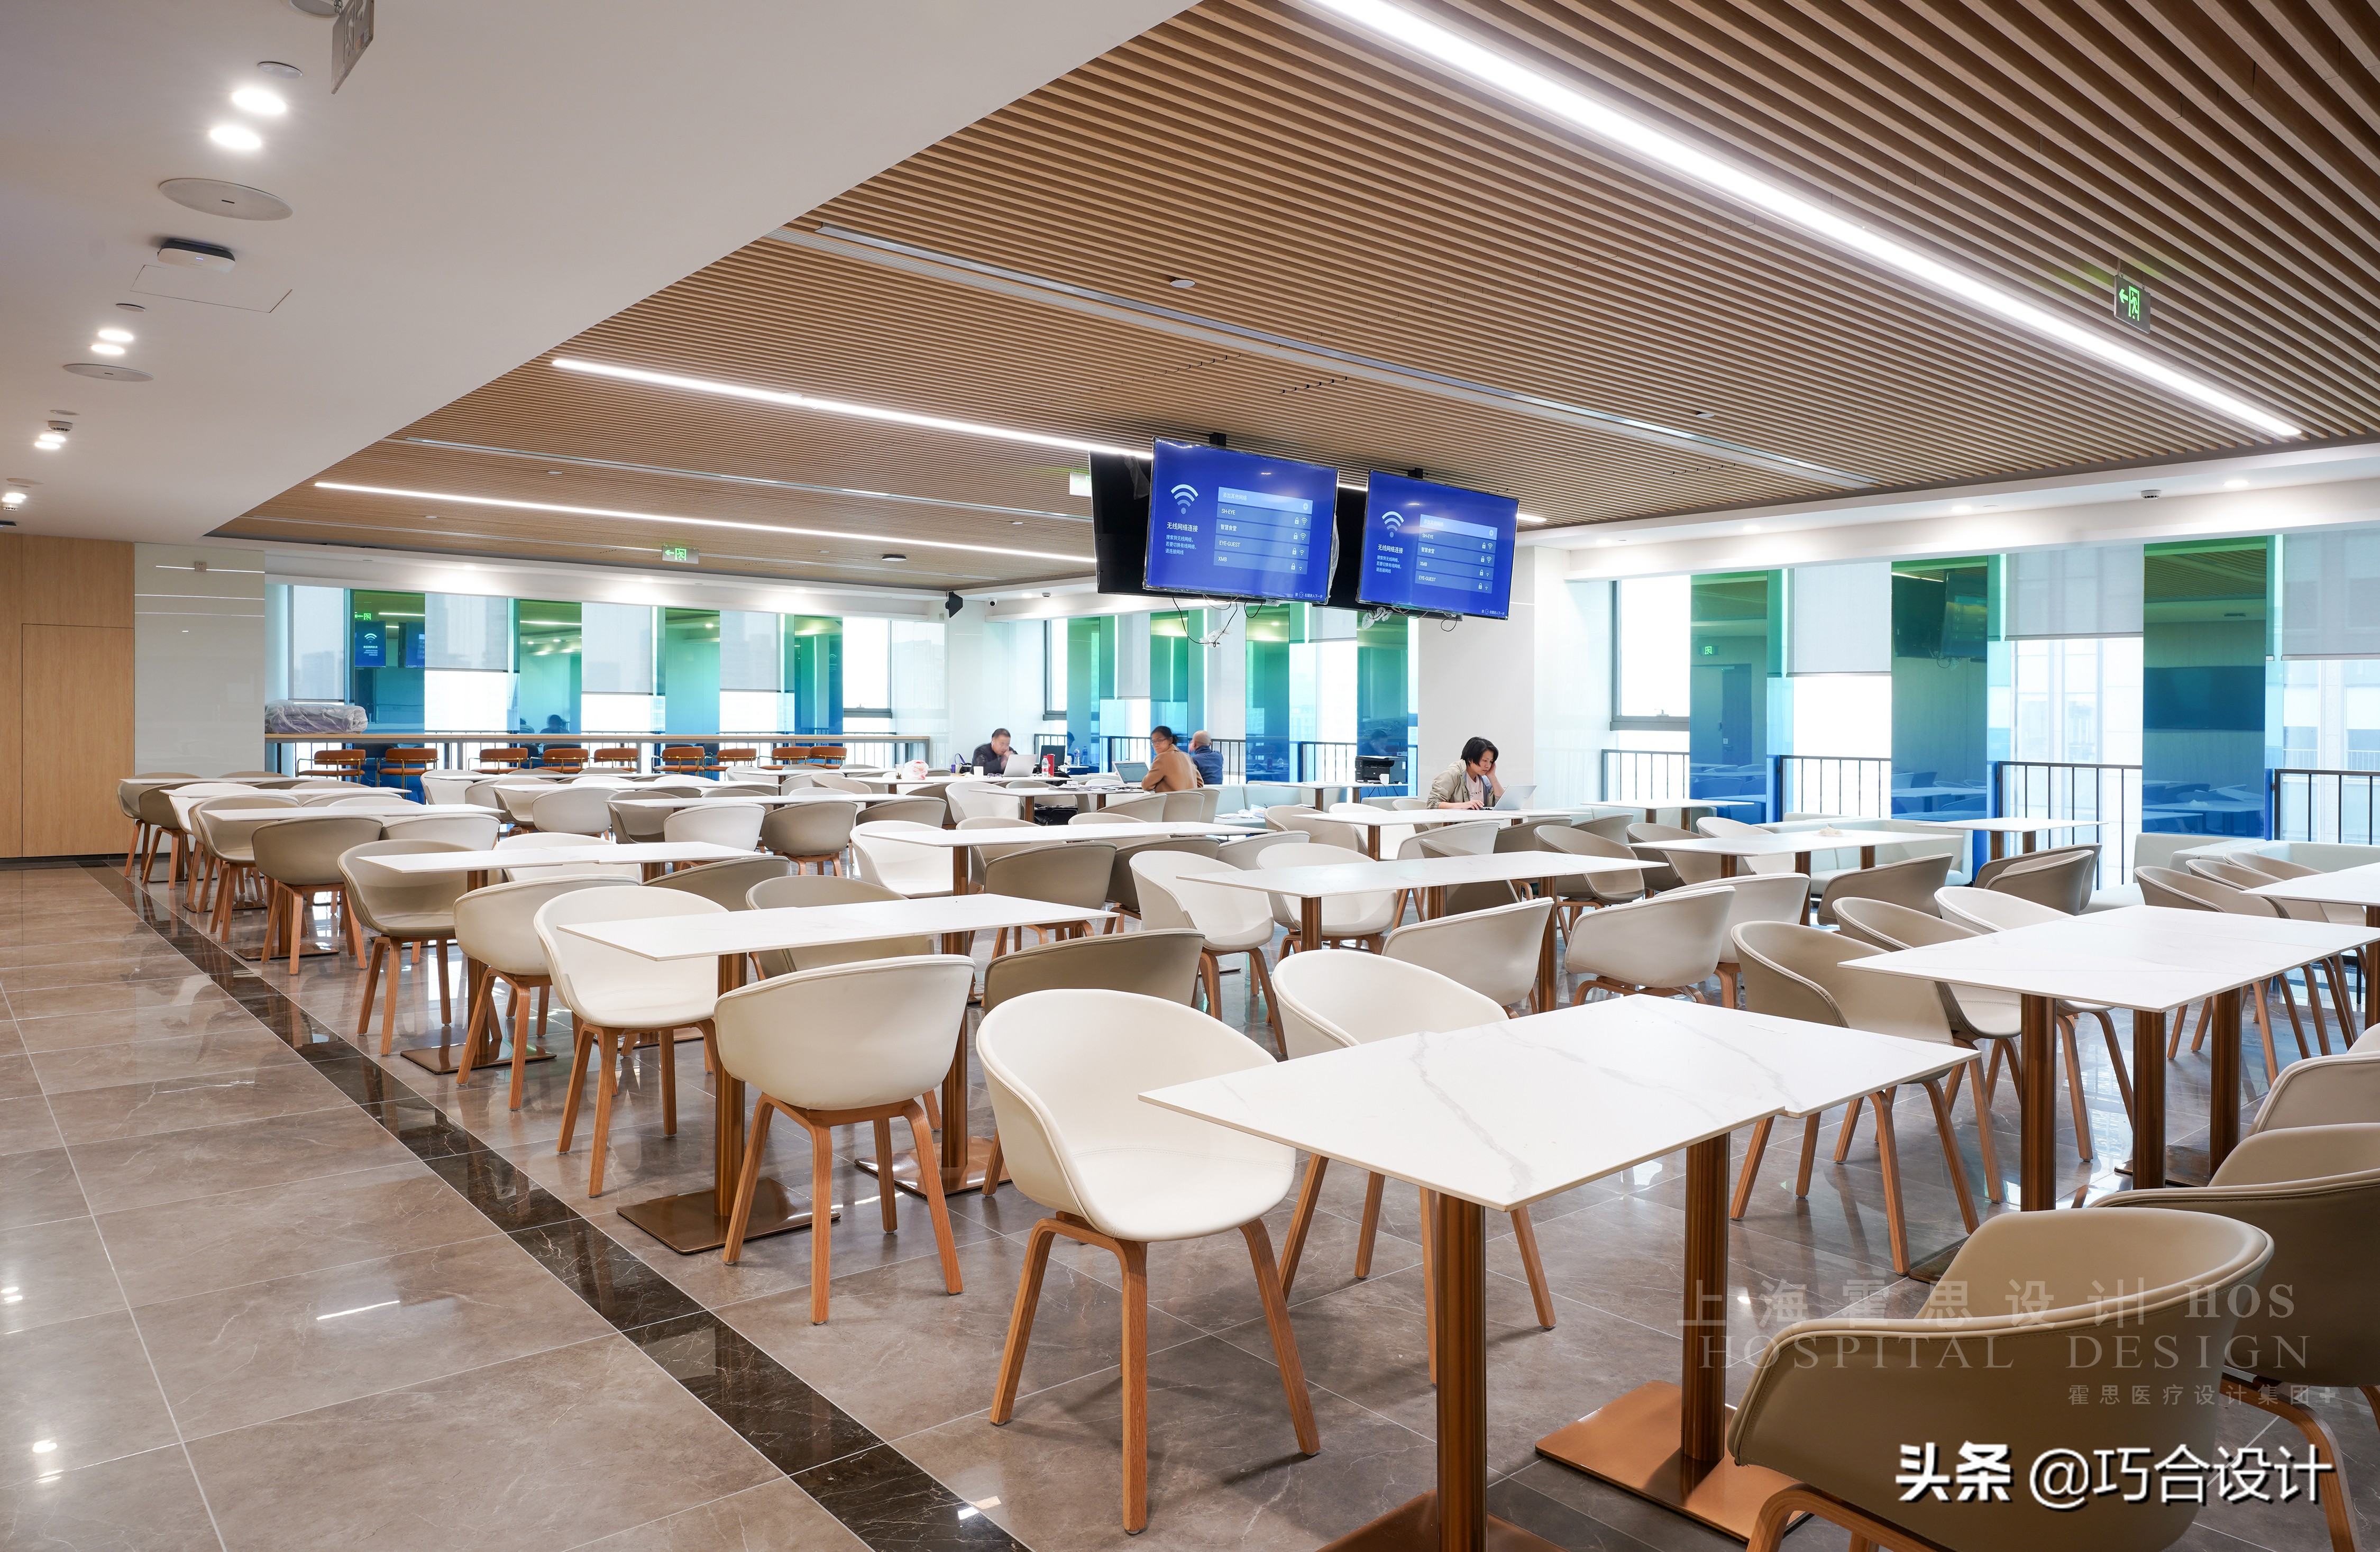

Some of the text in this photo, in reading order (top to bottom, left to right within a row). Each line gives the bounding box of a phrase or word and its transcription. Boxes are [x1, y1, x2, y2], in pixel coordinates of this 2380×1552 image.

[1223, 492, 1247, 501] 添加其他网络
[1167, 522, 1198, 533] 无线网络连接
[1378, 544, 1403, 554] 无线网络连接
